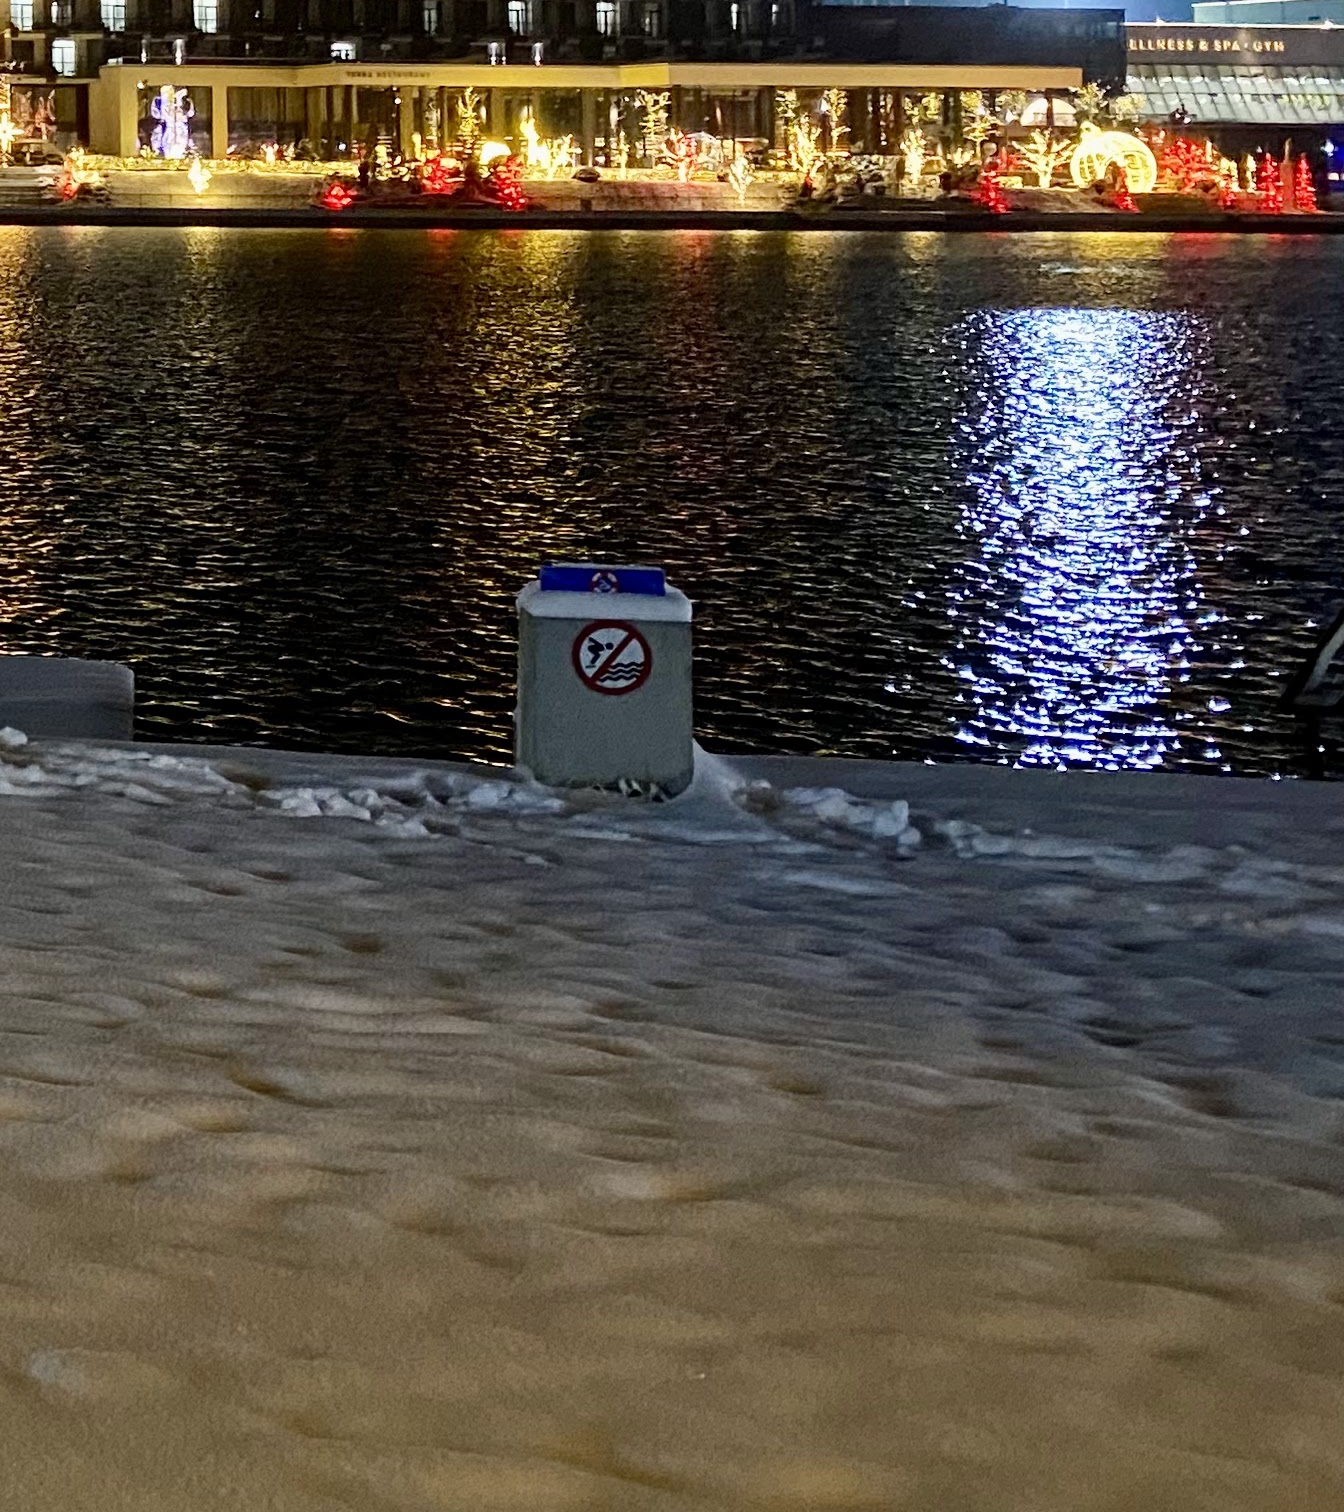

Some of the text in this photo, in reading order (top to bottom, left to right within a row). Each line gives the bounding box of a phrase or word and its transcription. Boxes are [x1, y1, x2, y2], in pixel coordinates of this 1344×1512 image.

[1128, 38, 1194, 52] ELLNESS
[1213, 39, 1241, 53] SPA
[1252, 40, 1285, 53] GYM
